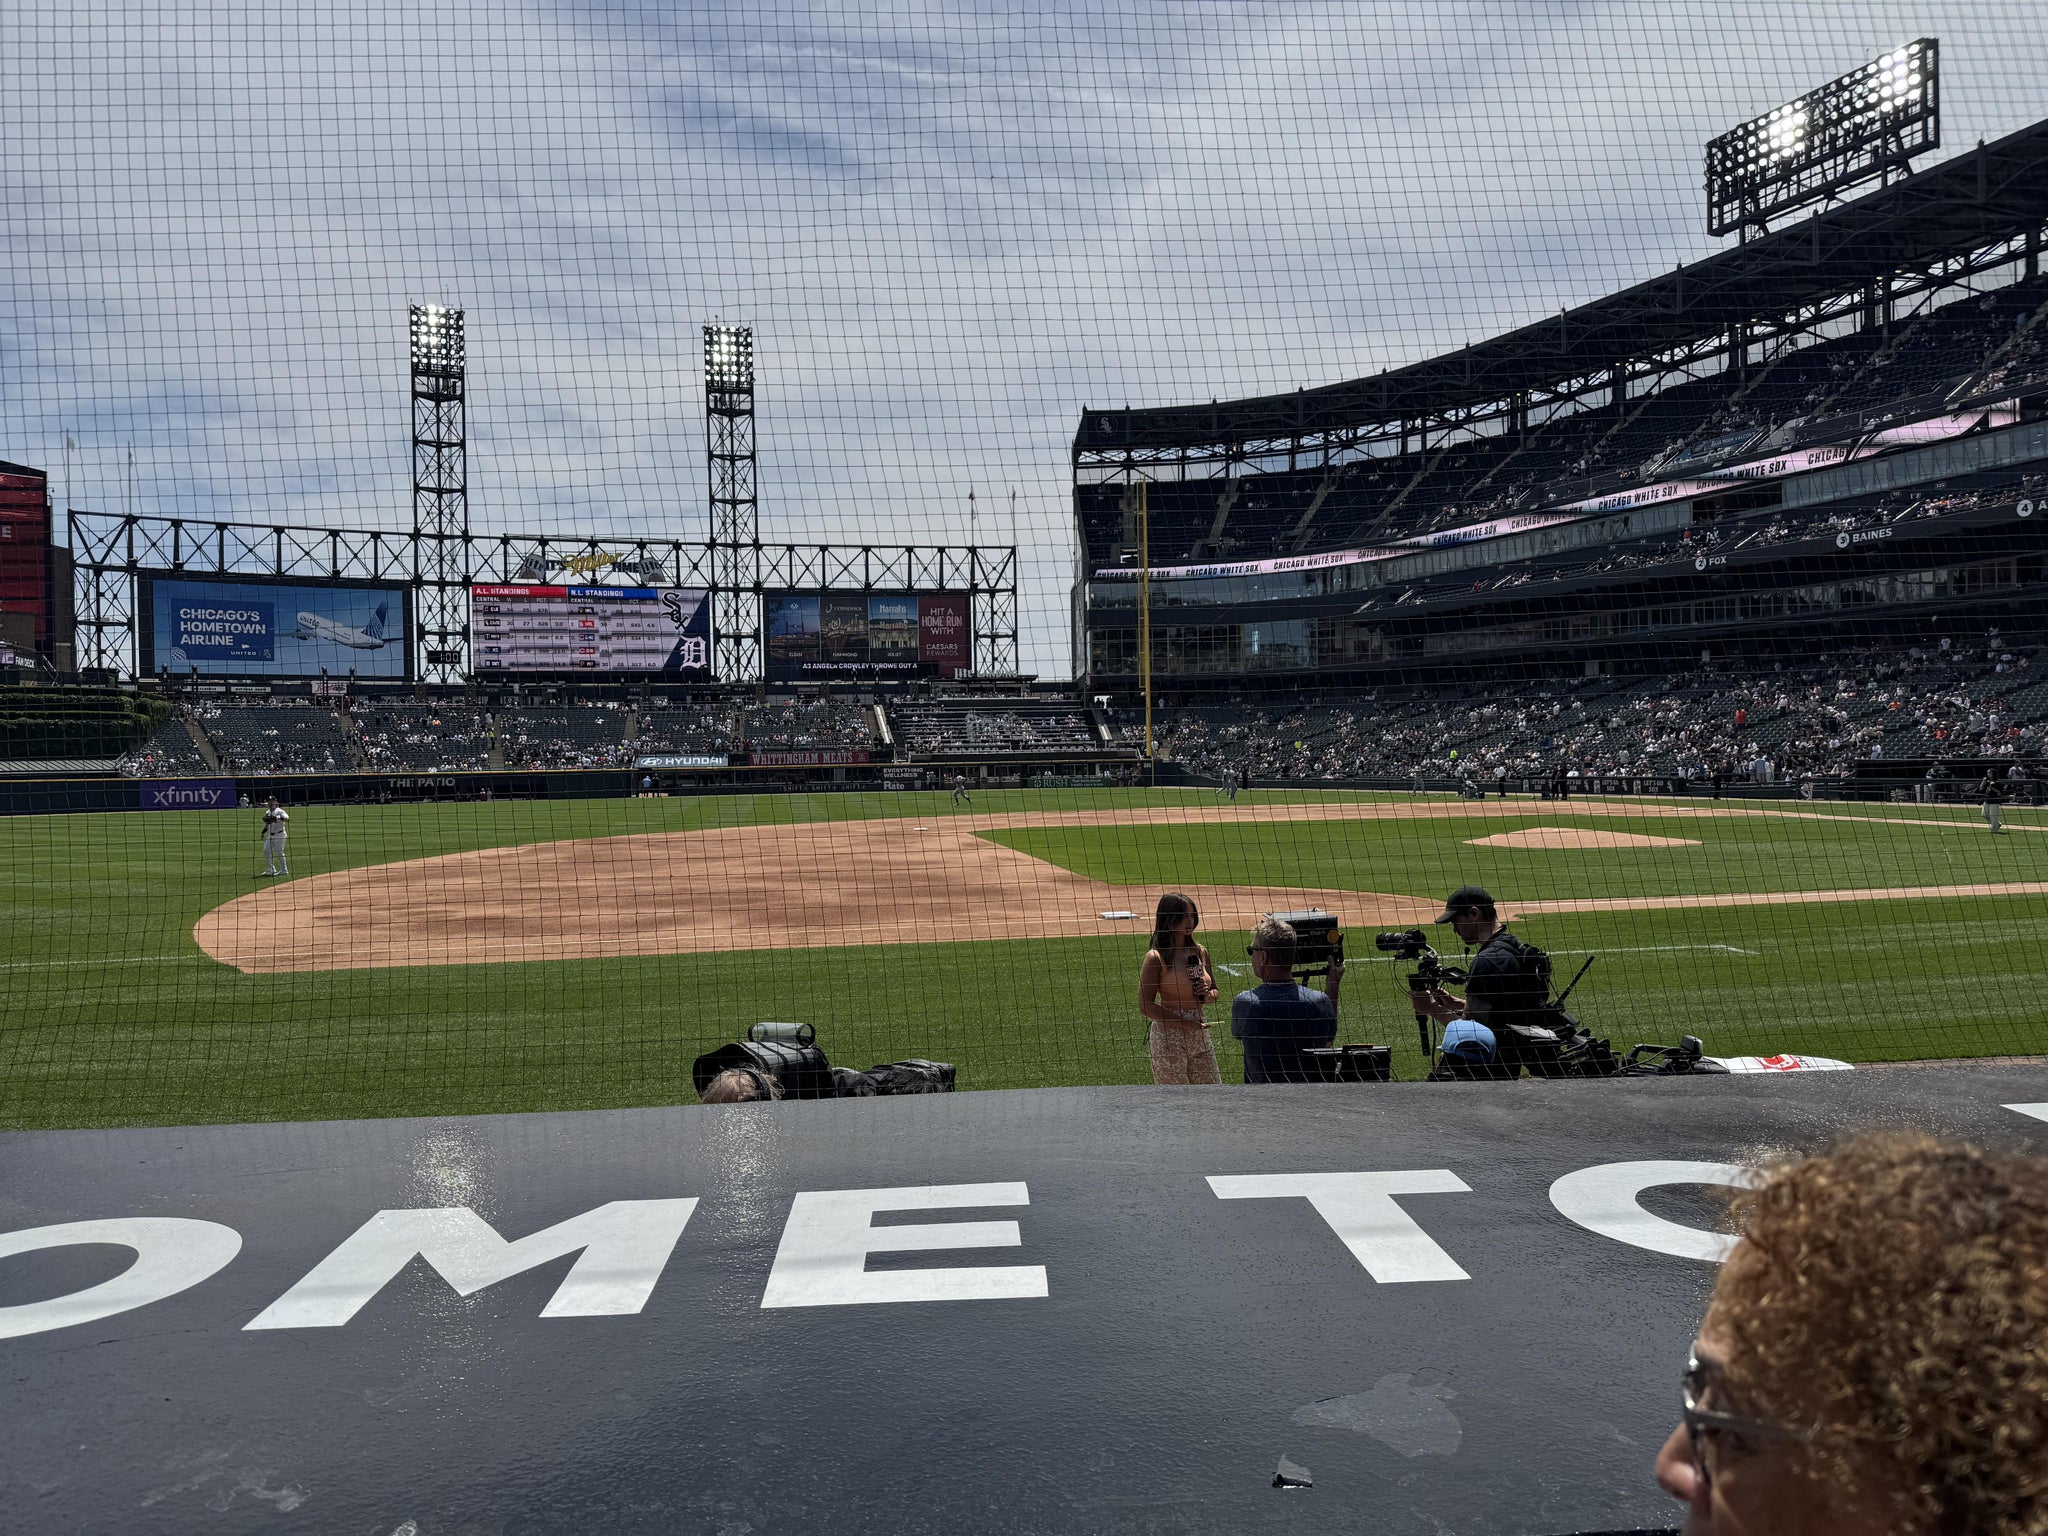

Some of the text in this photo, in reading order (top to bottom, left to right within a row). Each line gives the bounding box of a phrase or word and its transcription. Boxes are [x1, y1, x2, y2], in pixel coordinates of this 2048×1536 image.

[1737, 464, 1766, 479] WHITE
[1768, 460, 1787, 474] SOX
[1598, 484, 1679, 511] CHICAGO WHITE SOX
[1511, 516, 1541, 530] CHICAGO
[2, 525, 12, 538] E
[1432, 524, 1498, 546] CHICAGO WHITE SOX
[1852, 528, 1893, 543] BAINES
[561, 552, 624, 577] Miller
[1273, 553, 1344, 570] CHICAGO WHITE SOX
[1709, 555, 1727, 566] FOX
[1156, 570, 1171, 578] SOX
[1185, 564, 1259, 577] CHICAGO WHITE SOX
[179, 607, 261, 622] CHICAGO'S
[930, 607, 954, 616] HIT A
[300, 615, 320, 627] UNITED
[921, 616, 963, 627] HOME RUN
[180, 621, 266, 635] HOMETOWN
[930, 627, 954, 635] WITH
[180, 634, 234, 646] AIRLINE
[440, 652, 459, 662] 1:00
[954, 668, 973, 679] Lite
[665, 756, 722, 765] HYUNDAI
[752, 753, 818, 765] WHITTINGHAM
[823, 752, 853, 764] MEATS
[417, 777, 456, 787] PATIO
[883, 781, 905, 790] Rate
[1043, 779, 1068, 787] RUSH
[153, 786, 222, 806] xfinity
